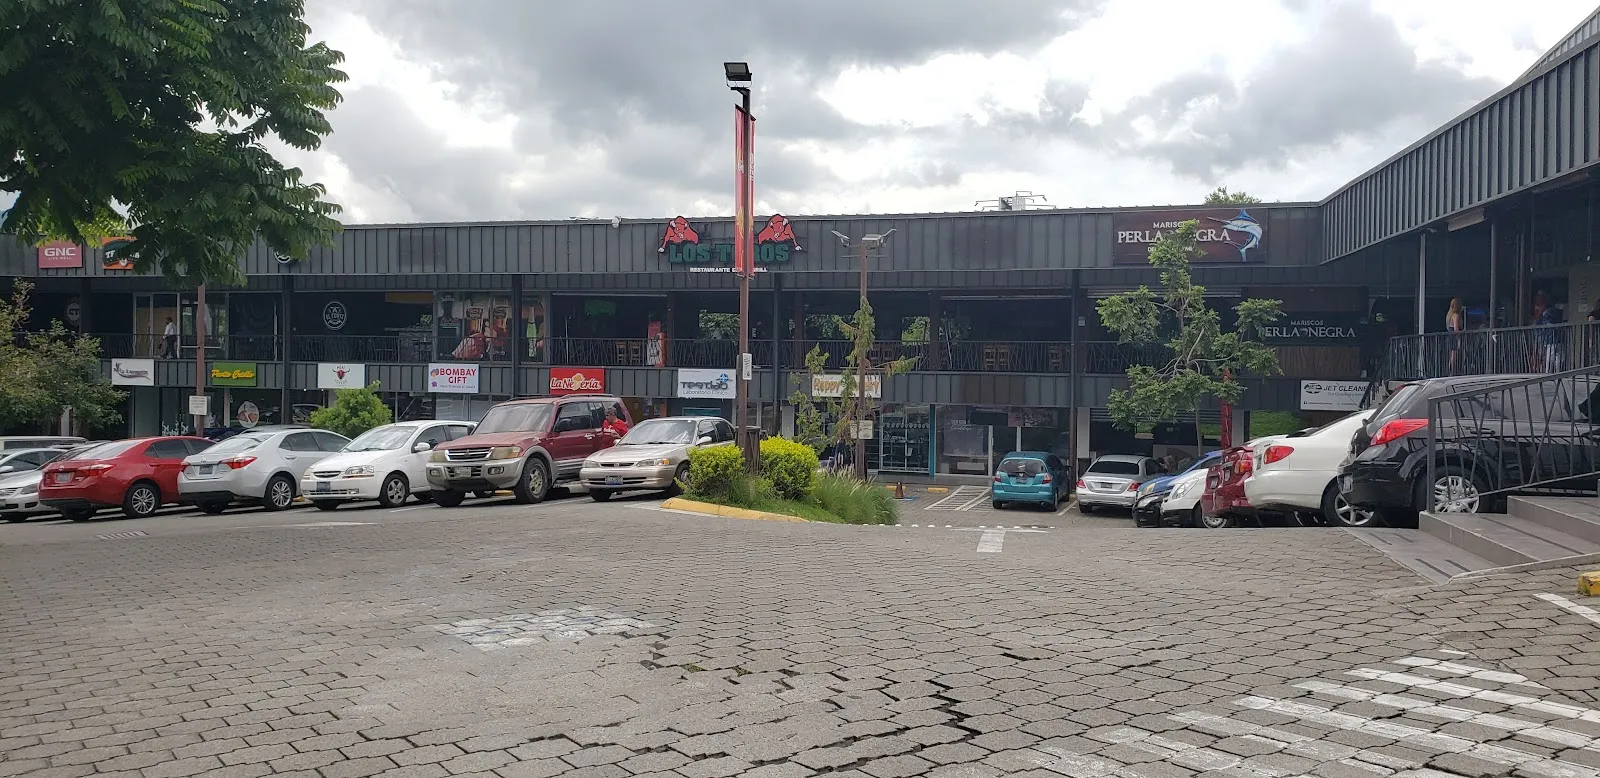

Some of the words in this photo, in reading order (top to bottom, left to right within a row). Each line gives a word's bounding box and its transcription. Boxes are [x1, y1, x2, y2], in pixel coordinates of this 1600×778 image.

[1153, 221, 1187, 229] MARISC
[1118, 230, 1164, 243] PERLA
[45, 247, 76, 257] GNC
[669, 243, 711, 263] LOS
[1265, 326, 1300, 337] ERLA
[1307, 326, 1356, 338] NEGRA
[440, 368, 477, 376] BOMBAY
[448, 376, 467, 384] GIFT
[550, 377, 562, 390] La
